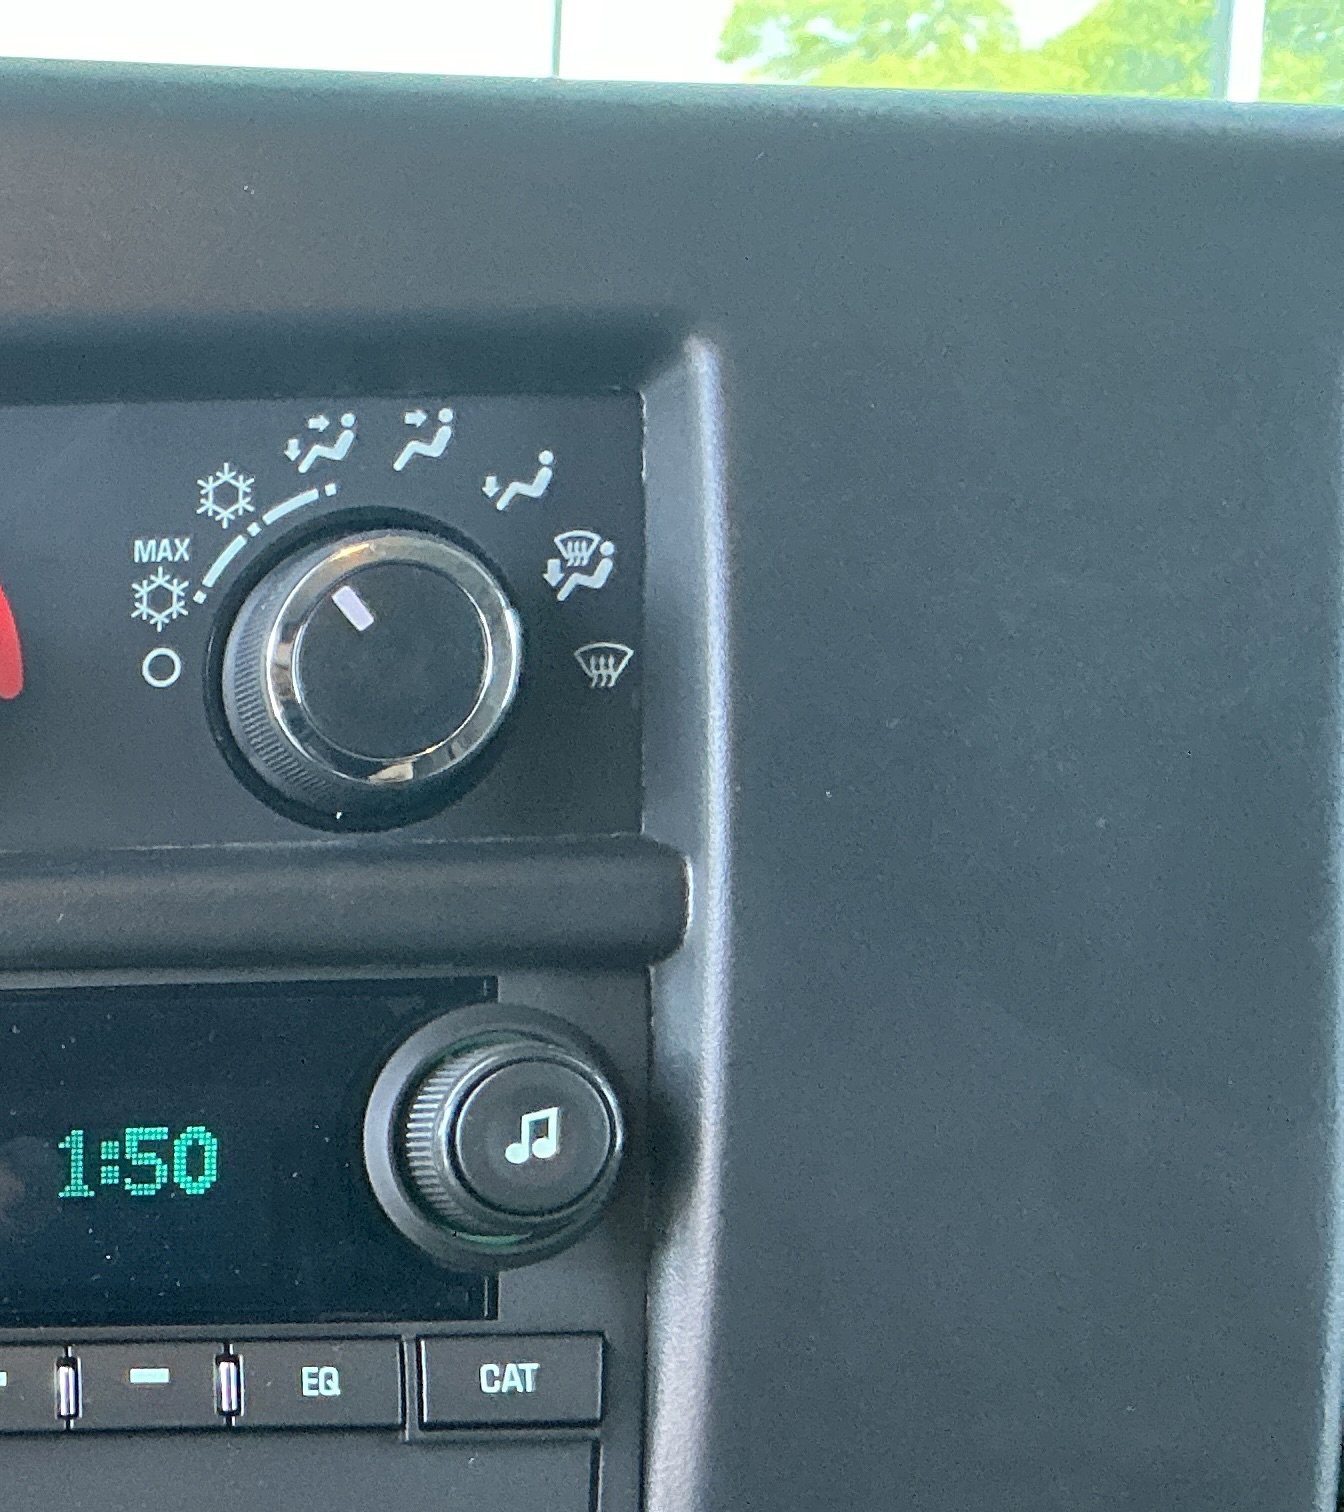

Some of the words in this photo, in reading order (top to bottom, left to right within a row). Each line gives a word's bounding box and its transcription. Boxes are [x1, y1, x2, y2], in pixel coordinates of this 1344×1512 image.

[134, 538, 190, 562] MAX
[58, 1126, 217, 1197] 1:50
[302, 1366, 340, 1396] EQ
[480, 1363, 540, 1393] CAT
